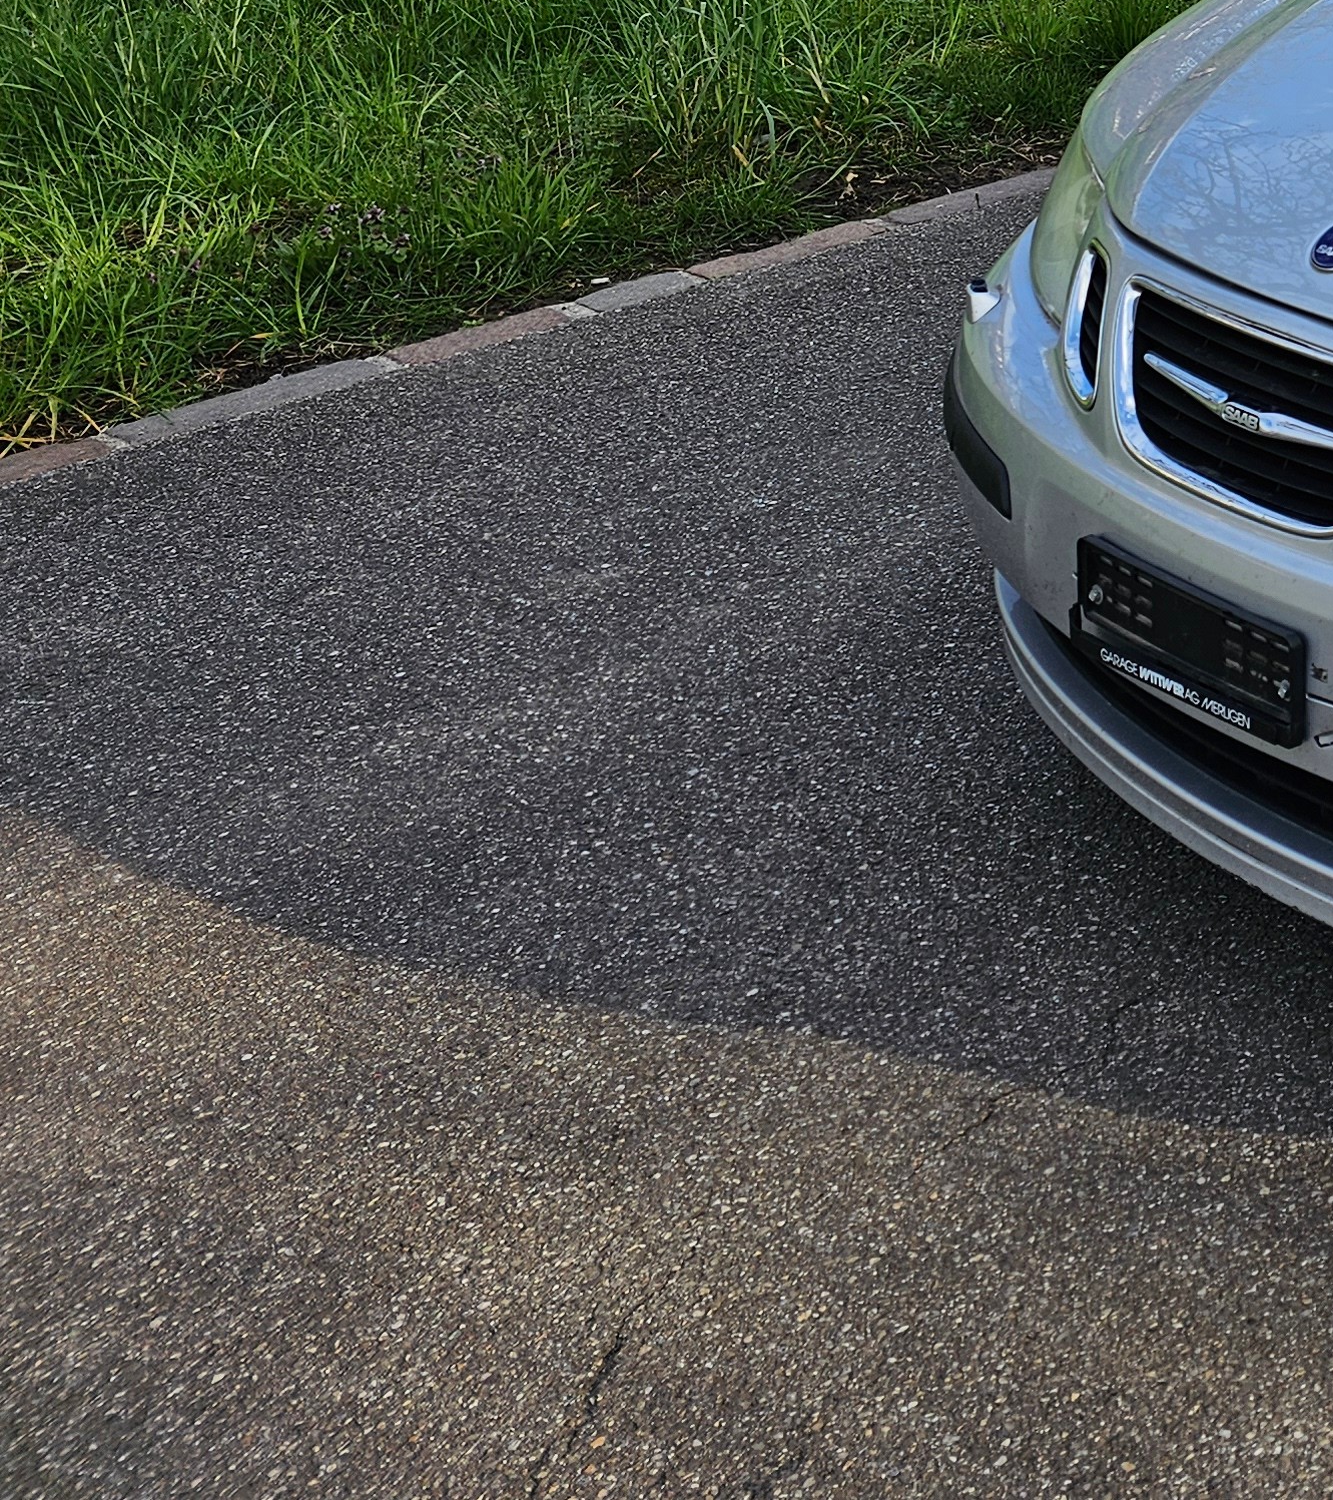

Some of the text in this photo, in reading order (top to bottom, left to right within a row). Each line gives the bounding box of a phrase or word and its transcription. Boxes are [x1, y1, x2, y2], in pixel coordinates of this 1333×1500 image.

[1224, 405, 1259, 431] SAAB
[1100, 647, 1138, 676] GARAGE
[1139, 665, 1184, 698] WITTWER
[1185, 688, 1200, 705] AG
